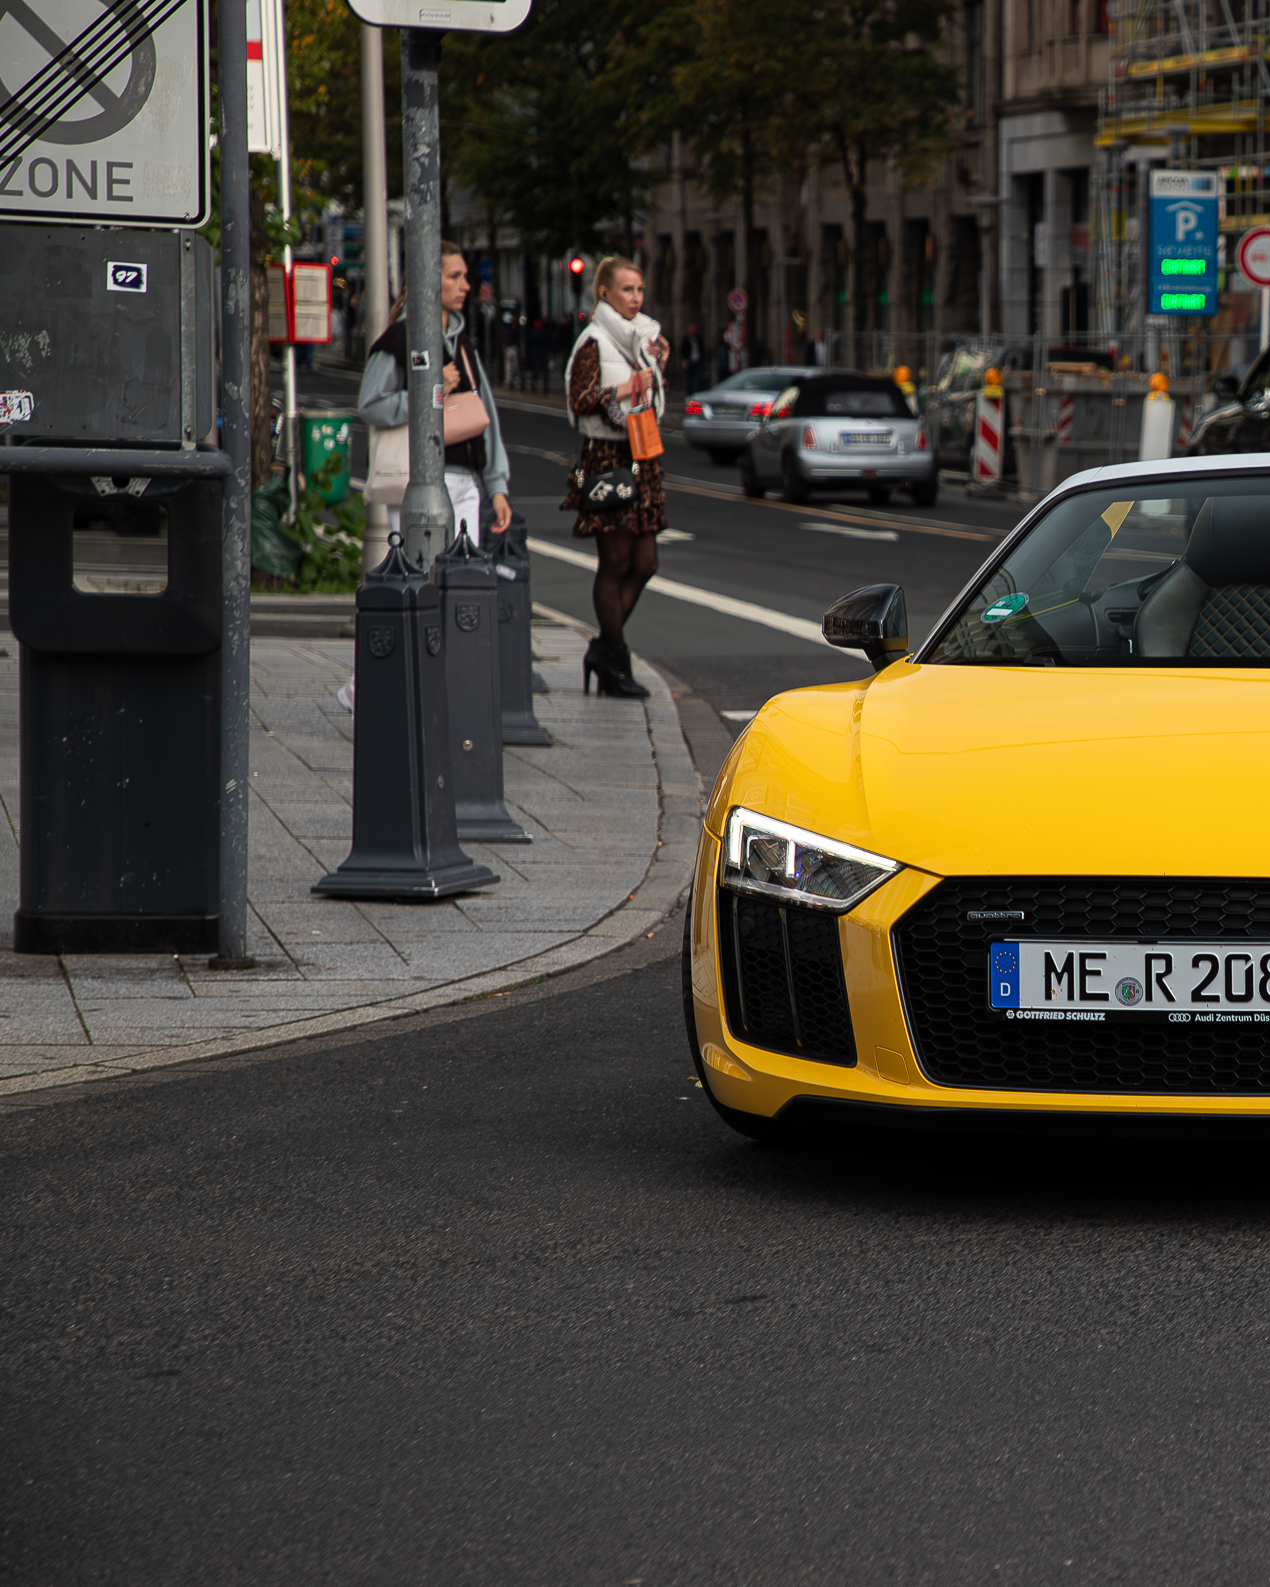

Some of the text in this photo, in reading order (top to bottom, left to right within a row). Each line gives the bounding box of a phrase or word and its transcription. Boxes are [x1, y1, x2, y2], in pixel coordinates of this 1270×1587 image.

[0, 154, 133, 202] ZONE
[1175, 210, 1199, 242] P
[115, 270, 138, 283] 97
[1044, 951, 1110, 1002] ME
[1145, 953, 1176, 1002] R
[1000, 982, 1011, 997] D
[1016, 1010, 1106, 1021] GOTTFRIED SCHULTZ
[1194, 1013, 1213, 1022] Audi
[1216, 1013, 1252, 1022] Zentrum
